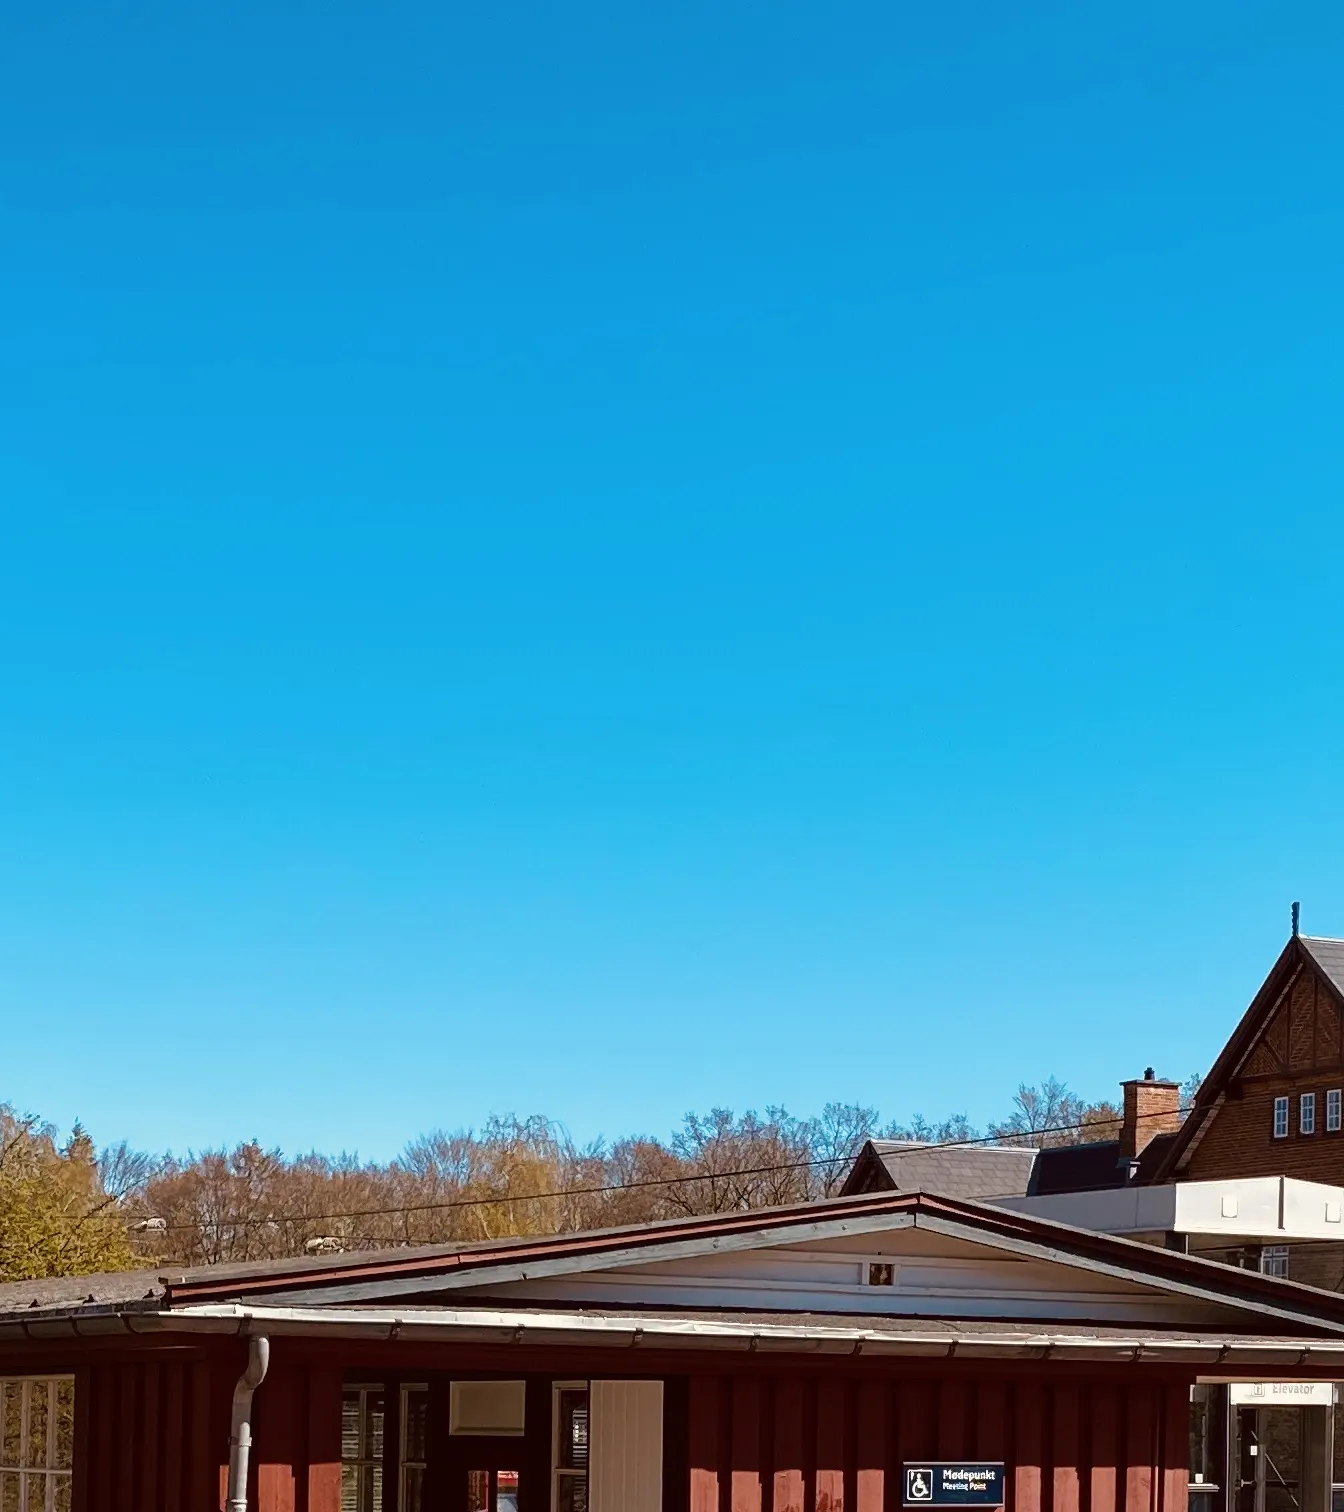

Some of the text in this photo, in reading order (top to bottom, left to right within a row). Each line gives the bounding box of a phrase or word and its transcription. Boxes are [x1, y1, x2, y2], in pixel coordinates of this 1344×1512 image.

[1272, 1383, 1315, 1395] Elevator
[942, 1469, 996, 1481] Mødepunkt
[942, 1482, 987, 1491] Meeting Point
